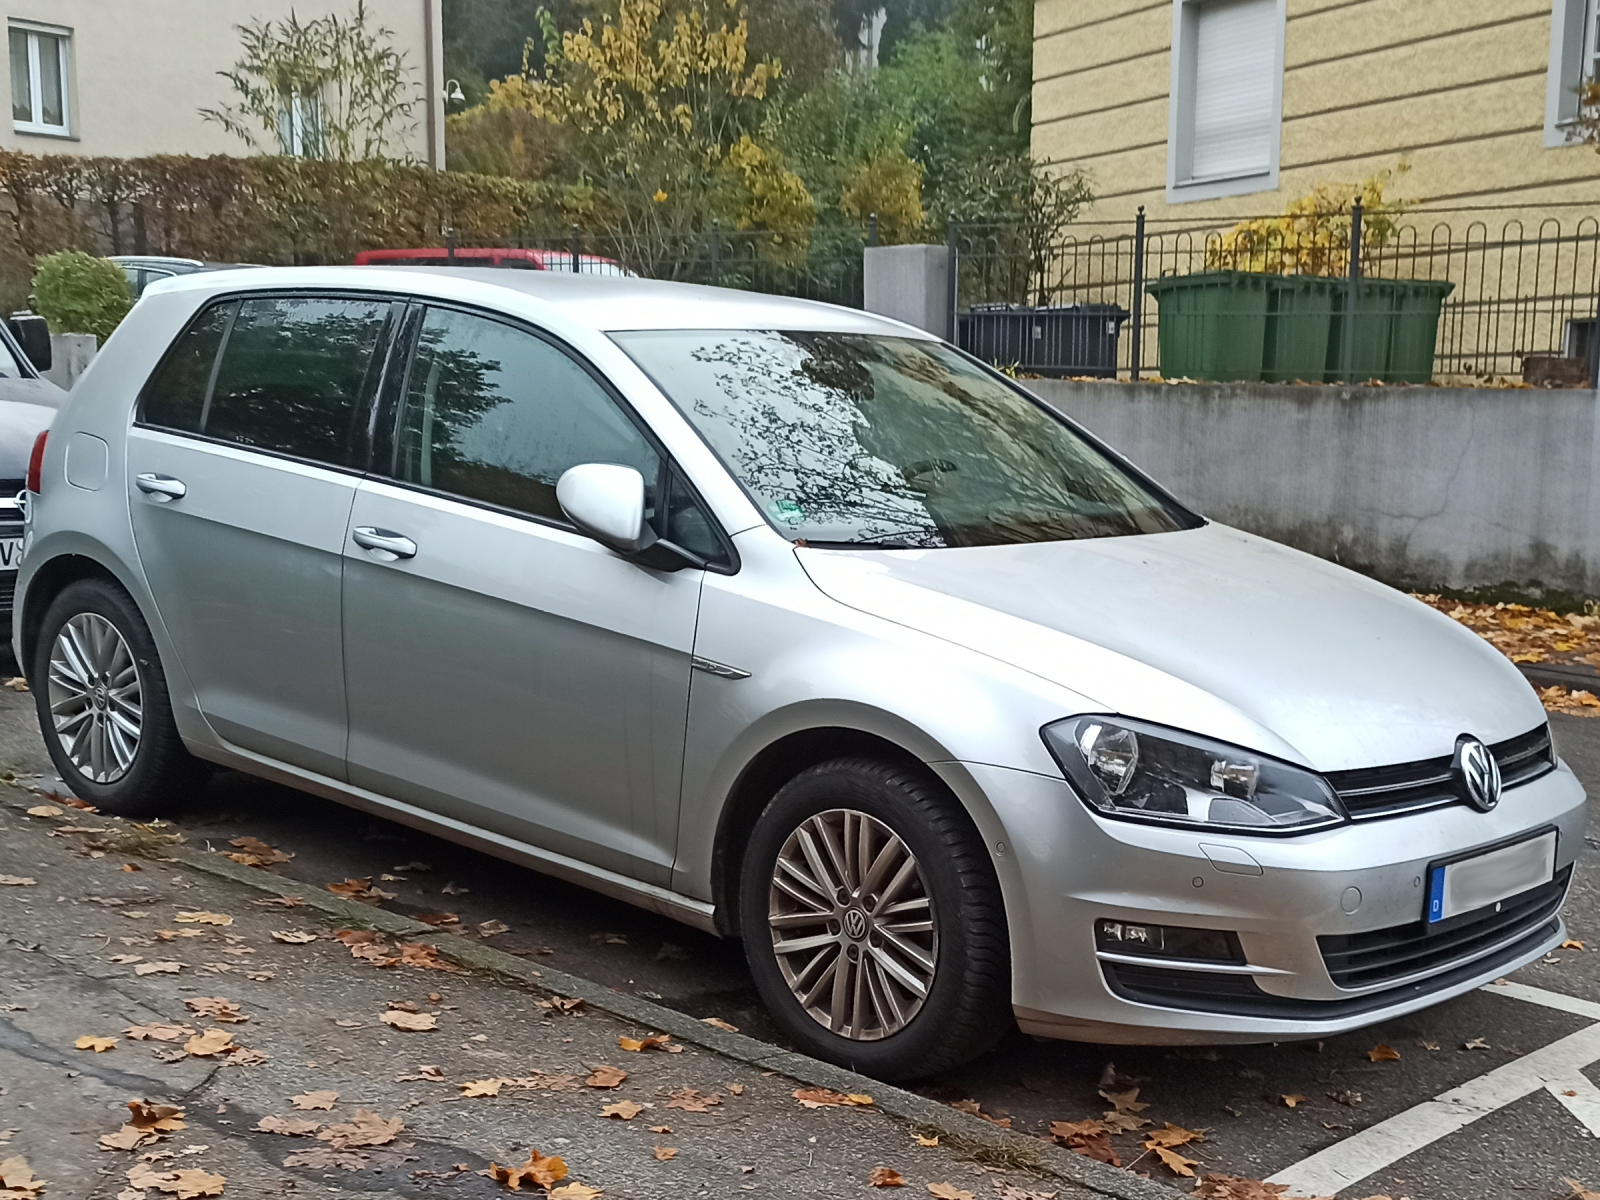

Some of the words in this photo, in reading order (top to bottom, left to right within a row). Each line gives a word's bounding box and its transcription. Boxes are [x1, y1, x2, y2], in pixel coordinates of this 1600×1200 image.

[1462, 742, 1501, 808] VW
[1433, 899, 1439, 912] D
[844, 910, 866, 938] VW
